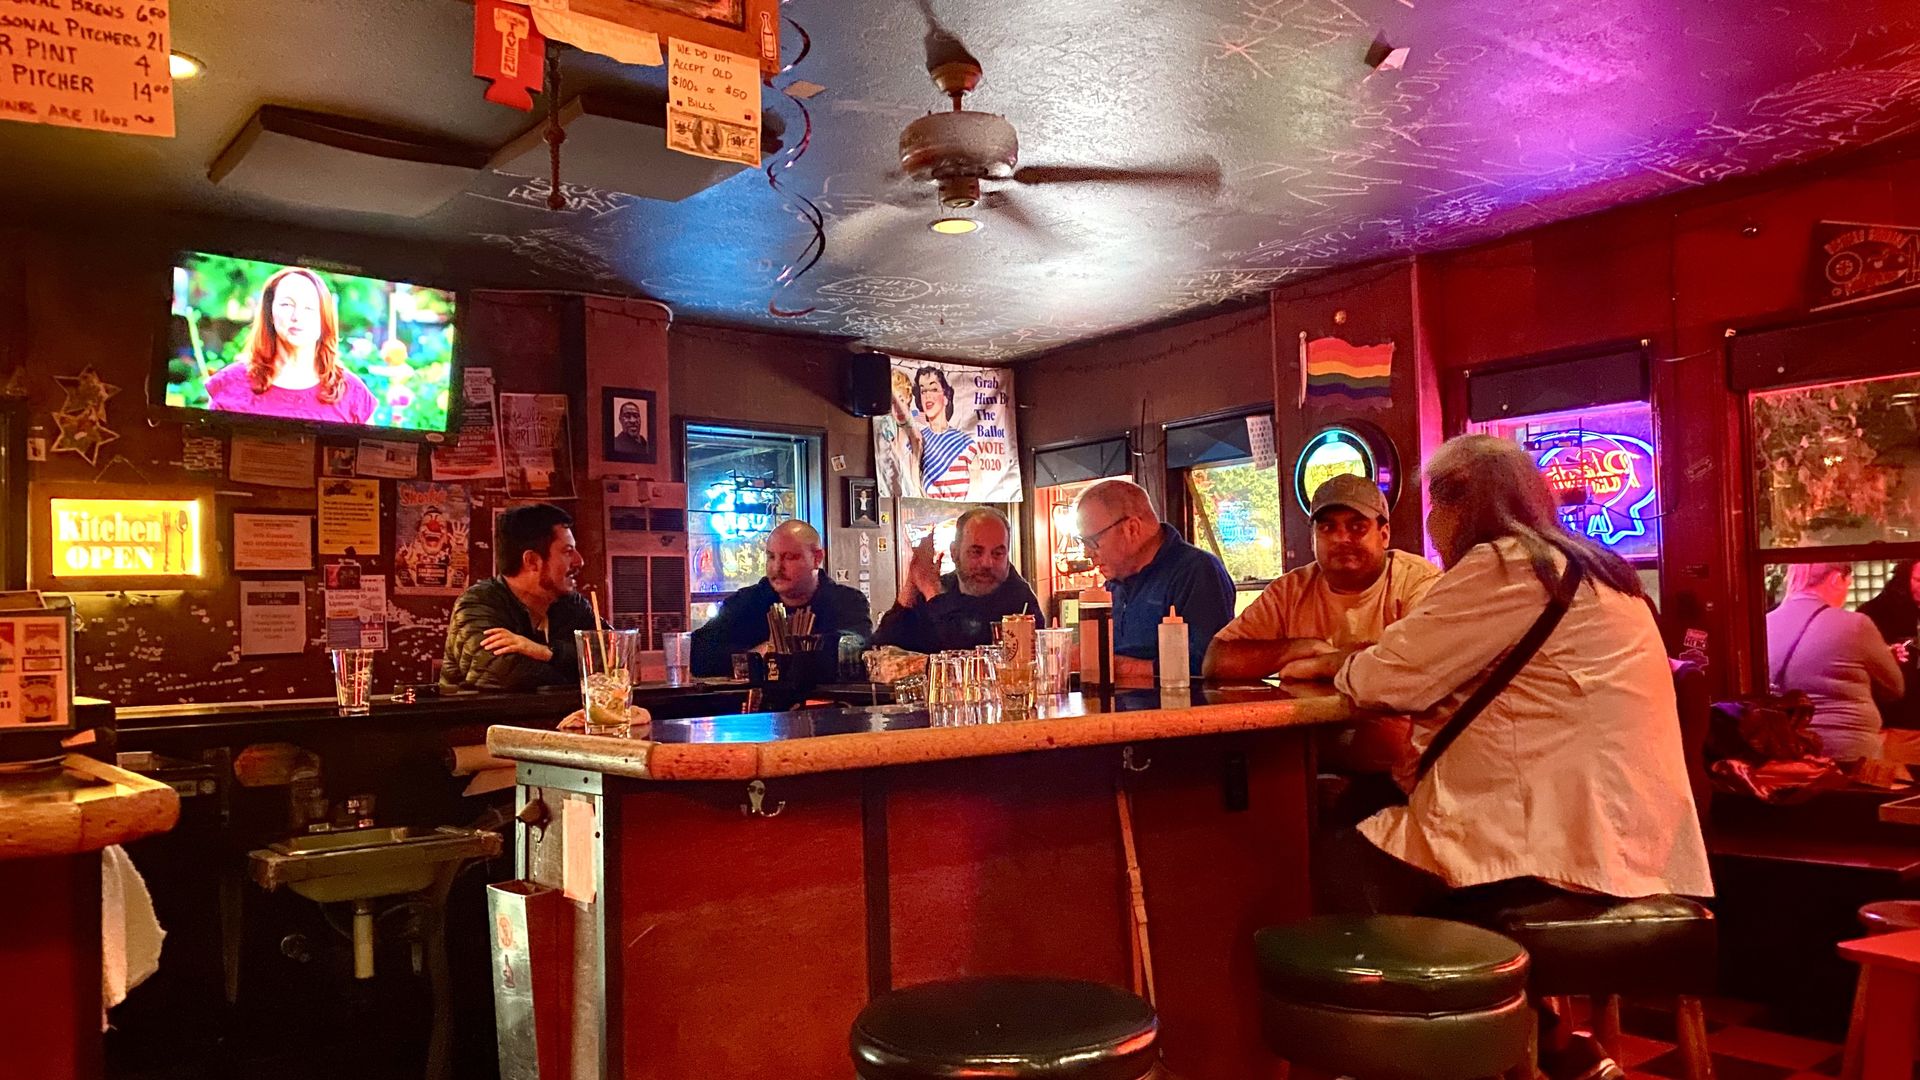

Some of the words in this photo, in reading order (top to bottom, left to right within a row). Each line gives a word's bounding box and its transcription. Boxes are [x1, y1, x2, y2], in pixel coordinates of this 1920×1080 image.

[65, 18, 141, 48] PITCHERS
[147, 31, 164, 52] 21
[26, 38, 78, 64] PINT
[134, 54, 151, 77] 4
[677, 43, 691, 55] WE
[694, 48, 708, 60] DO
[714, 53, 732, 64] NOT
[673, 58, 705, 74] ACCEPT
[712, 67, 733, 80] OLD
[12, 63, 94, 95] PITCHER
[725, 84, 748, 100] $50
[48, 103, 82, 123] ARE
[974, 375, 999, 389] Grab
[974, 392, 998, 405] Him
[975, 408, 996, 421] The
[977, 424, 1005, 438] Ballot
[977, 441, 1005, 455] VOTE
[979, 459, 1001, 471] 2020
[57, 509, 162, 543] Kitchen
[65, 545, 155, 570] OPEN
[367, 635, 377, 643] 10
